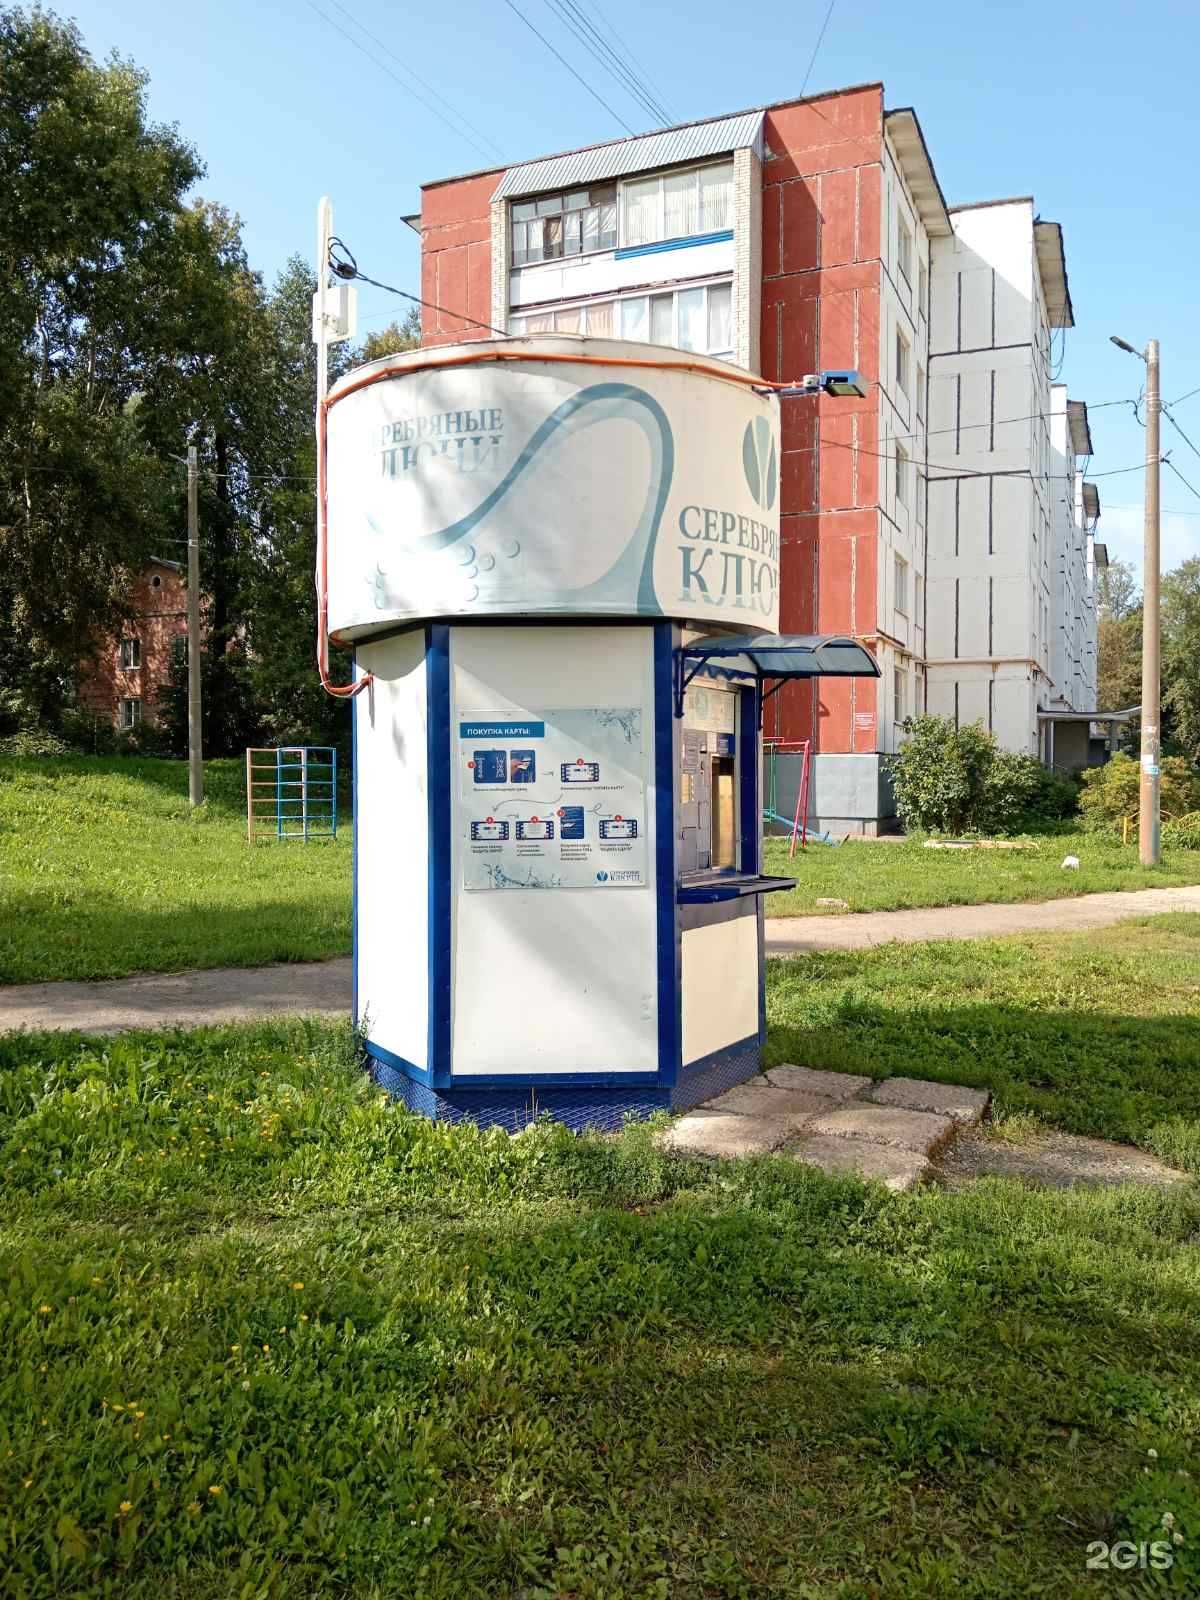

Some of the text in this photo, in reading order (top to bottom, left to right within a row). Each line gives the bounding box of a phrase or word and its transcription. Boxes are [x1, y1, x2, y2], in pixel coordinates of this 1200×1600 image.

[380, 408, 504, 446] РЕБРЯНЫЕ
[379, 435, 504, 480] ЛЮЧИ
[678, 505, 778, 563] СЕРЕБРЯ
[677, 545, 778, 616] КЛЮ
